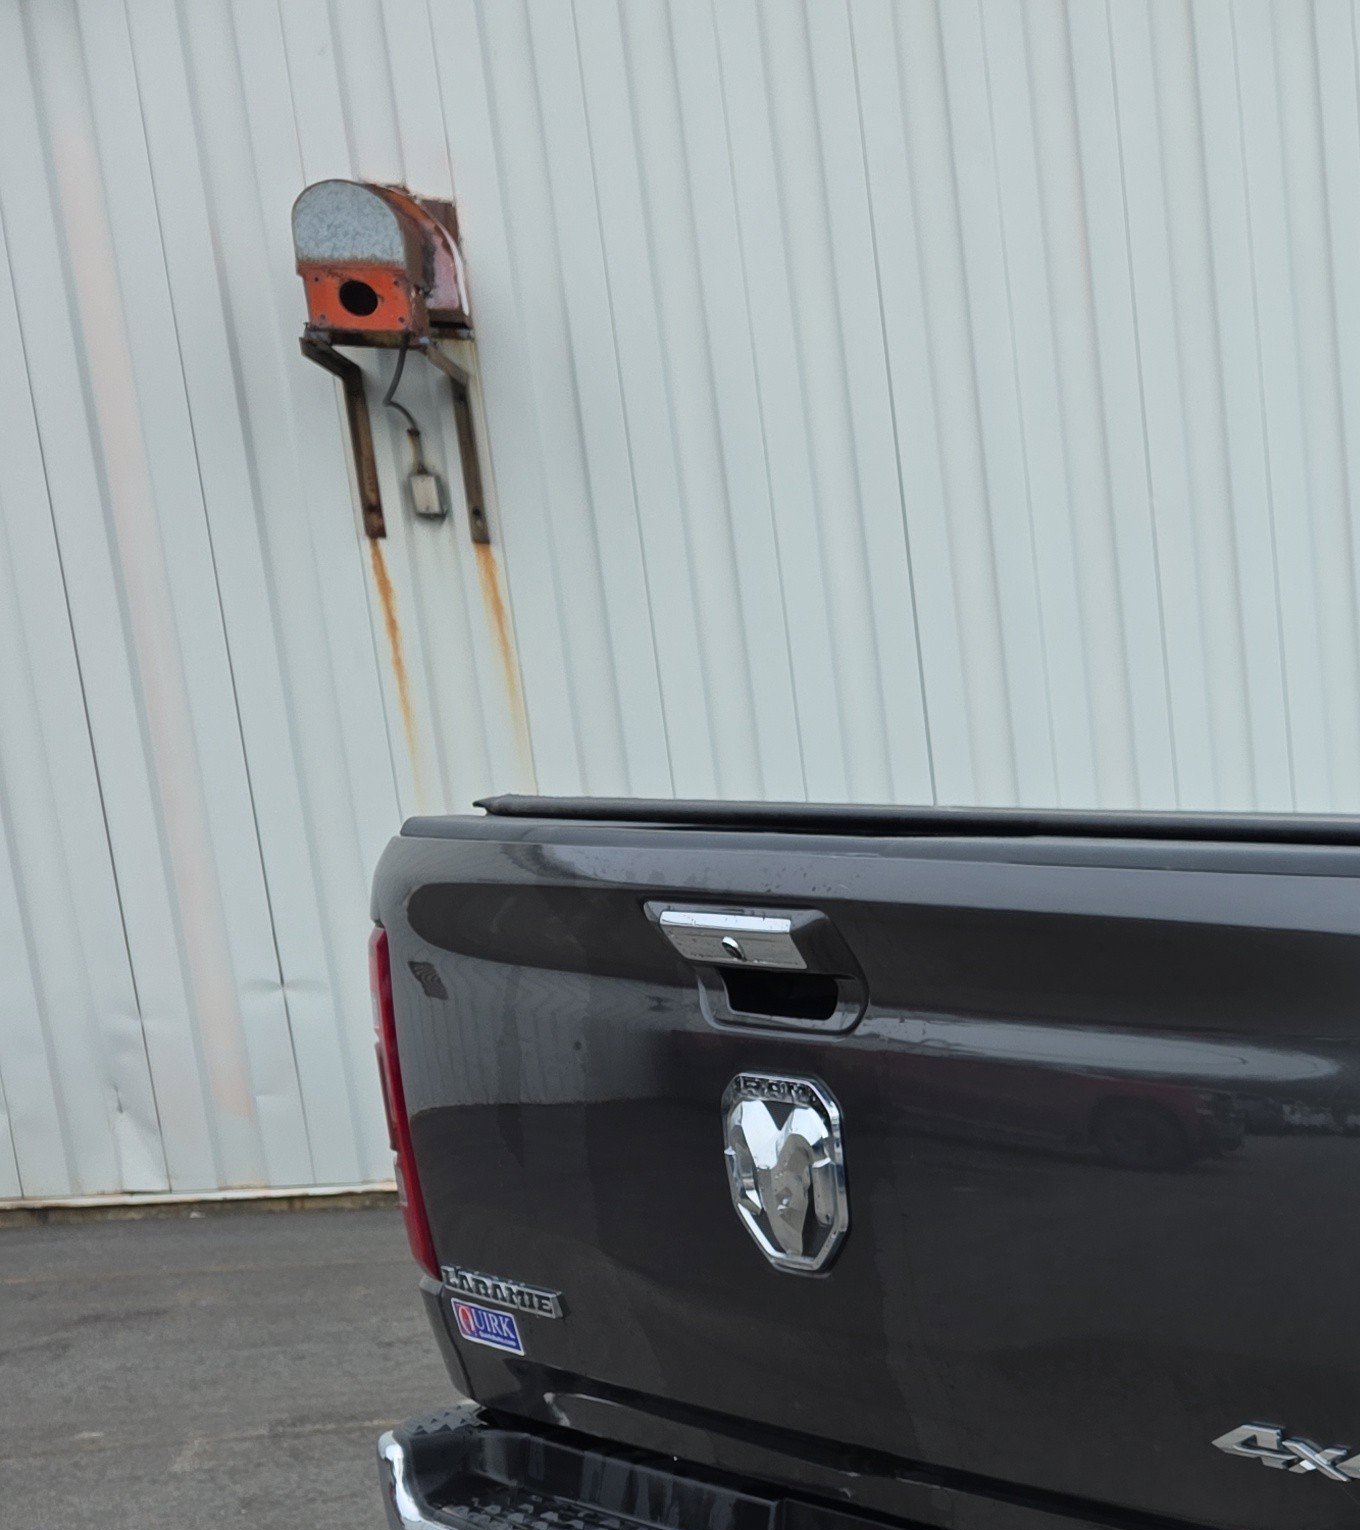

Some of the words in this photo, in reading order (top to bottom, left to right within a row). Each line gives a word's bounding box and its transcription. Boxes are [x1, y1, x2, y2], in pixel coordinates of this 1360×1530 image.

[739, 1076, 811, 1104] RAM
[443, 1267, 555, 1315] LARAMIE
[458, 1304, 516, 1340] QUIRK
